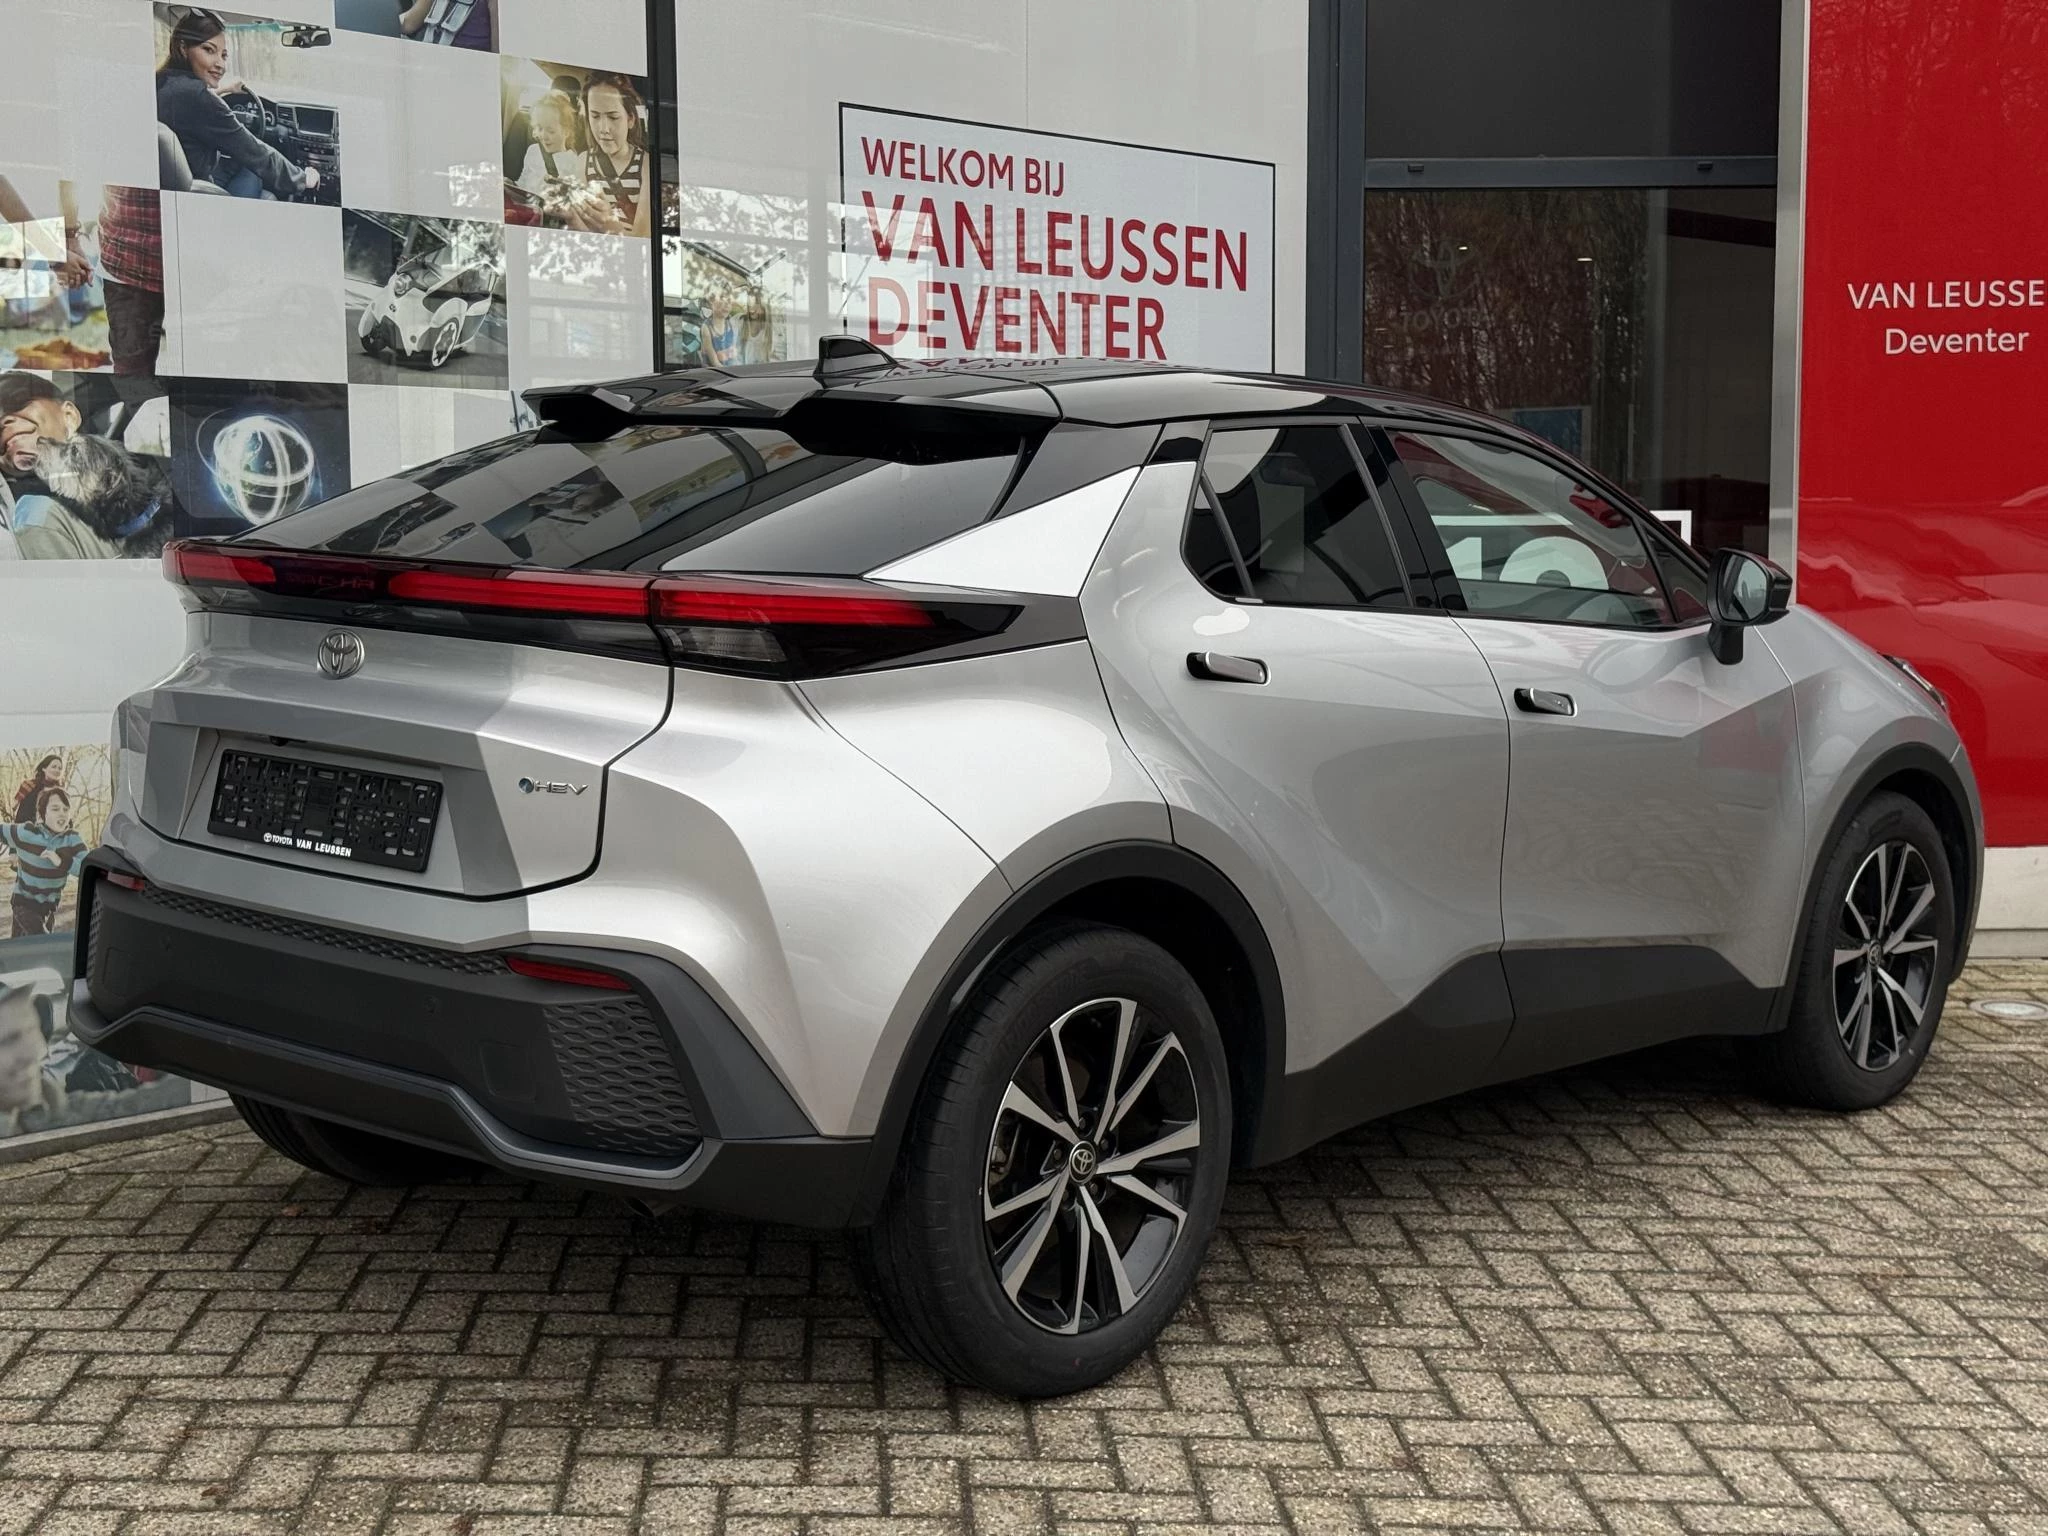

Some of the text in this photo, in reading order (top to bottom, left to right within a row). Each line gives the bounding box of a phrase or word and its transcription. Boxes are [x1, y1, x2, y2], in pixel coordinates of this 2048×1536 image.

[861, 137, 1065, 198] WELKOM BIJ
[861, 191, 1248, 292] VAN LEUSSEN
[1847, 280, 2046, 310] VAN LEUSSE
[868, 276, 1168, 361] DEVENTER
[1884, 327, 2030, 355] Deventer
[535, 779, 589, 796] HEV
[272, 834, 352, 858] TOYOTA VAN LEUSSEN
